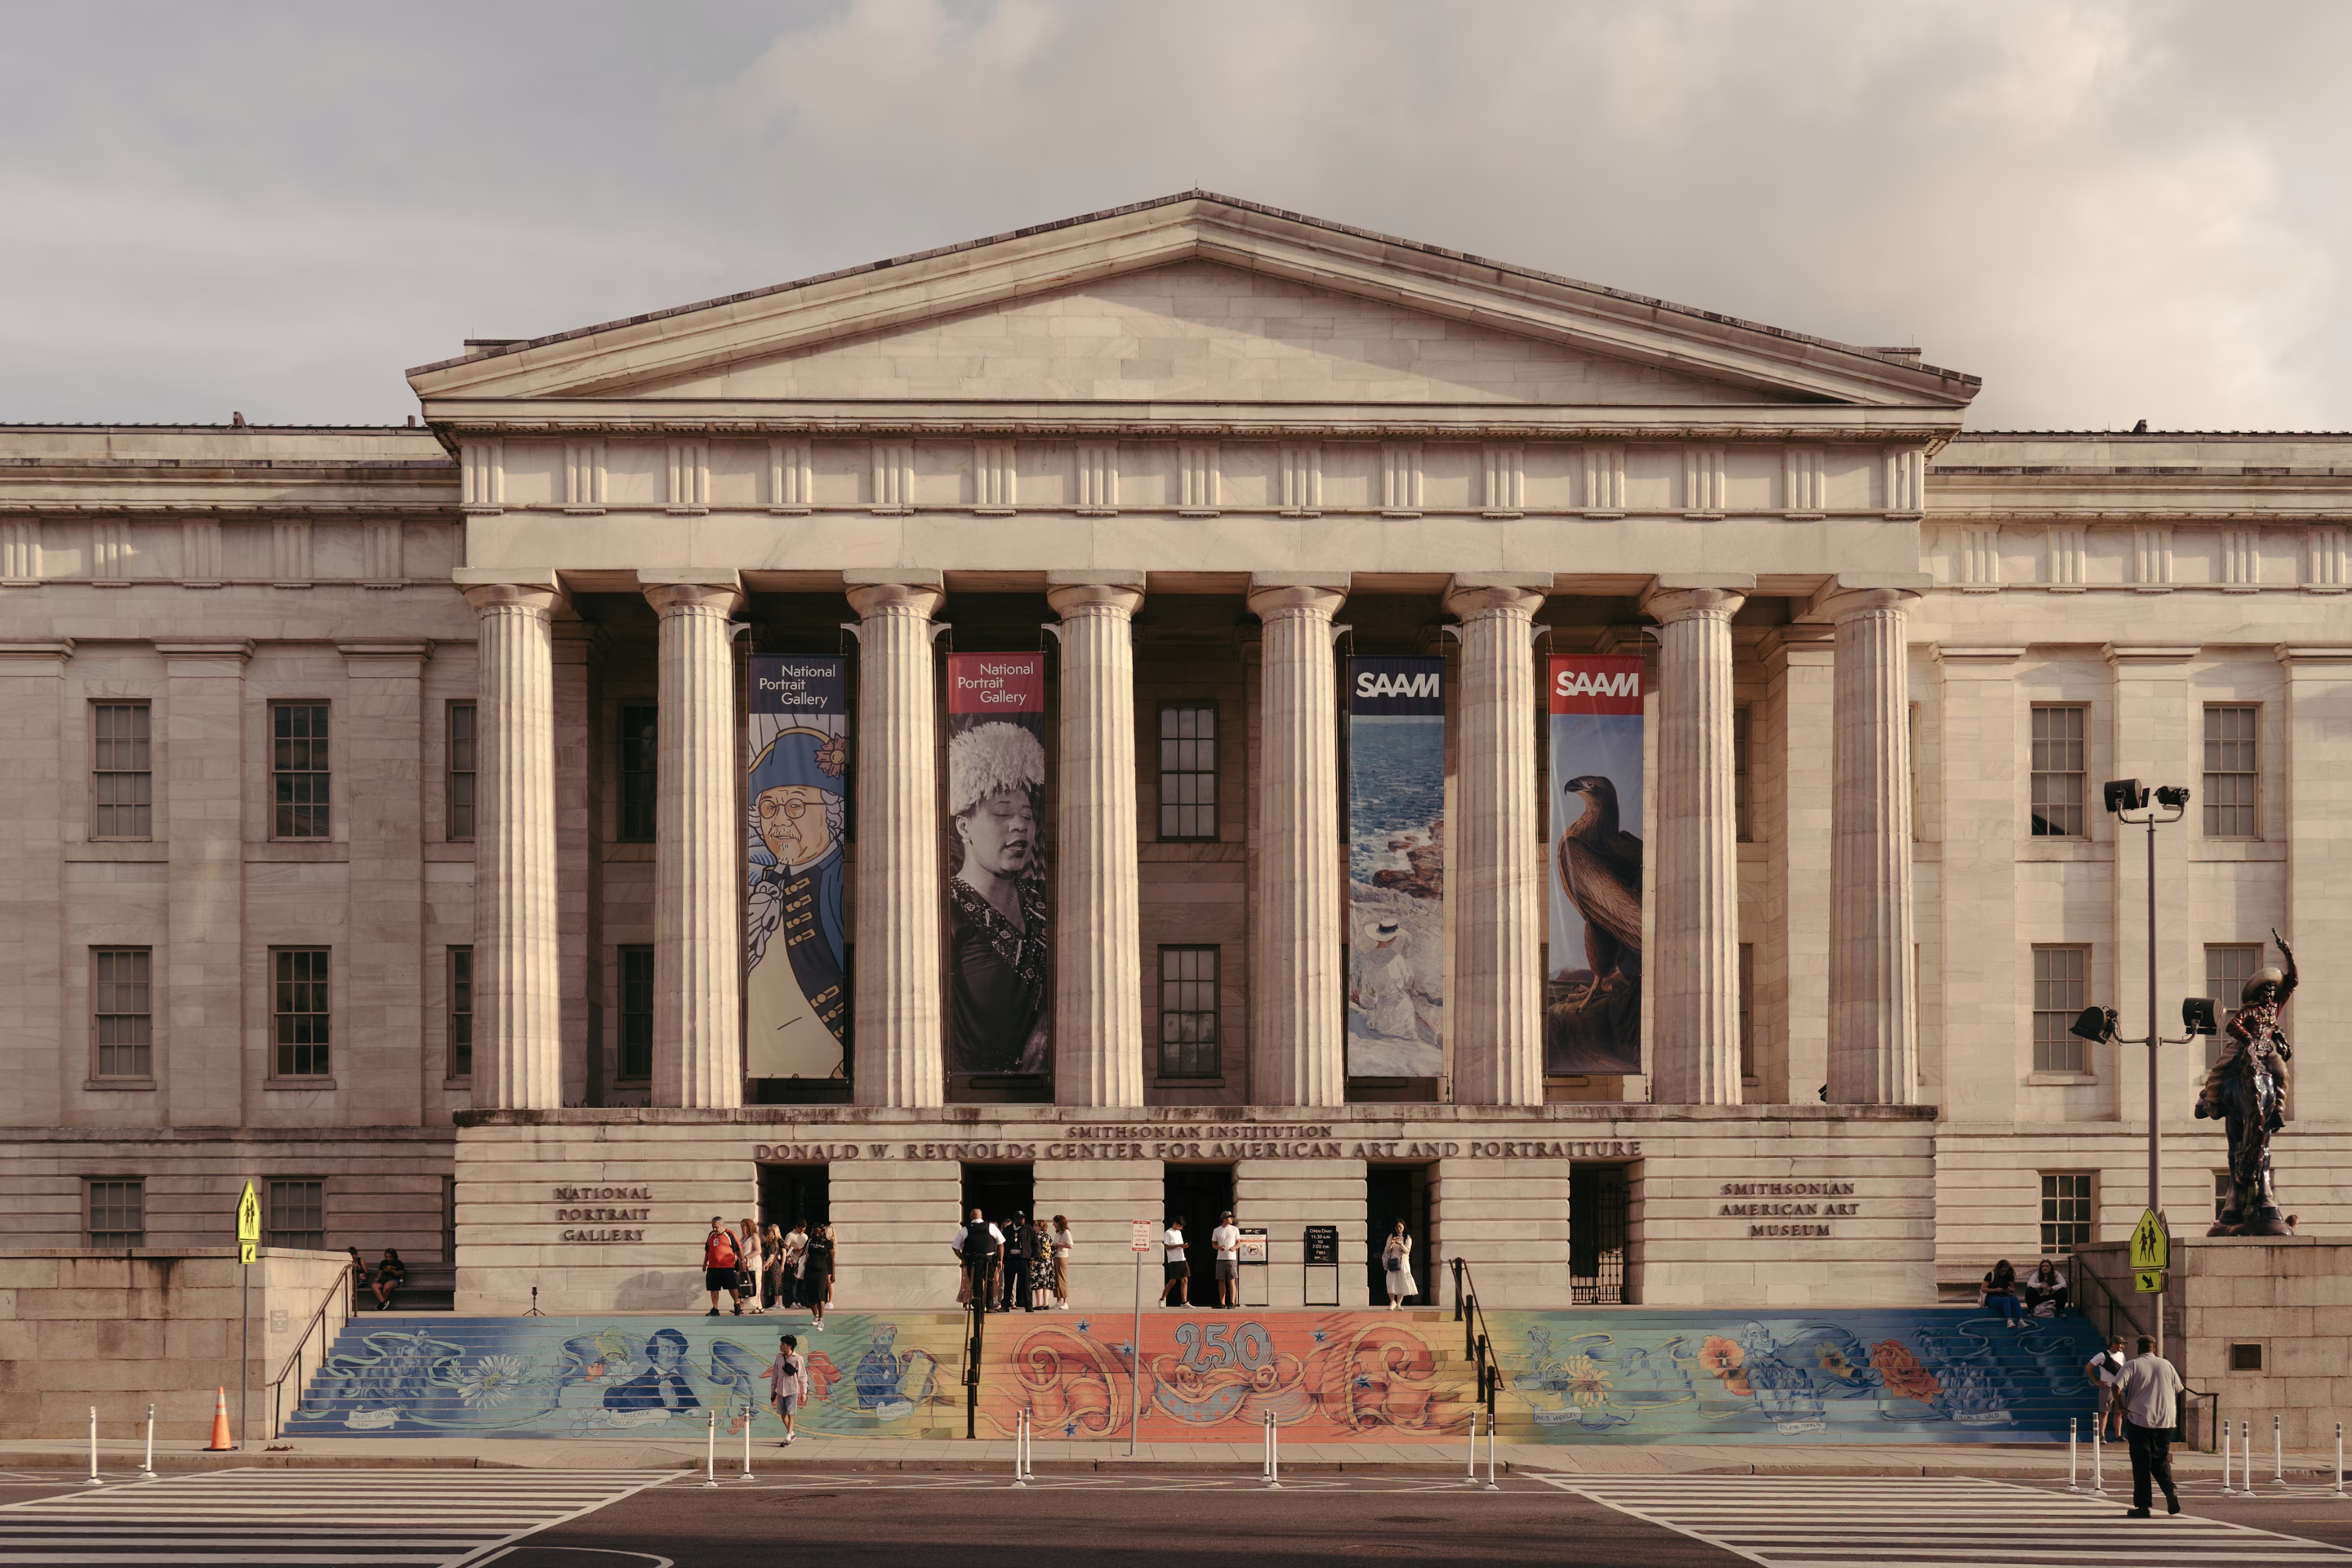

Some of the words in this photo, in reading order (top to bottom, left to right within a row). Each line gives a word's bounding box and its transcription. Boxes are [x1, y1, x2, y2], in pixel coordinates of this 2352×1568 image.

[782, 664, 835, 678] National
[980, 662, 1034, 675] National
[760, 678, 806, 690] Portrait
[958, 676, 1004, 688] Portrait
[1356, 672, 1440, 697] SAAM
[1556, 671, 1639, 697] SAAM
[782, 692, 828, 709] Gallery
[980, 689, 1027, 706] Gallery
[1067, 1125, 1201, 1138] SMITHSONIAN
[1209, 1125, 1333, 1138] INSTITUTION
[755, 1144, 858, 1160] DONALD
[870, 1144, 895, 1159] W.
[906, 1143, 1036, 1159] REYNOLDS
[1047, 1143, 1145, 1159] CENTER
[1156, 1143, 1204, 1159] FOR
[1212, 1143, 1343, 1158] AMERICAN
[1354, 1142, 1398, 1158] ART
[1409, 1142, 1459, 1158] AND
[1471, 1141, 1643, 1158] PORTRAITURE
[555, 1187, 653, 1200] NATIONAL
[1723, 1183, 1855, 1196] SMITHSONIAN
[557, 1209, 651, 1221] PORTRAIT
[1720, 1203, 1818, 1216] AMERICAN
[1824, 1203, 1860, 1215] ART
[562, 1229, 645, 1241] GALLERY
[1749, 1224, 1831, 1236] MUSEUM
[1174, 1321, 1273, 1374] 250
[621, 1410, 651, 1419] FREDERICK
[1553, 1413, 1577, 1421] WHEATLEY
